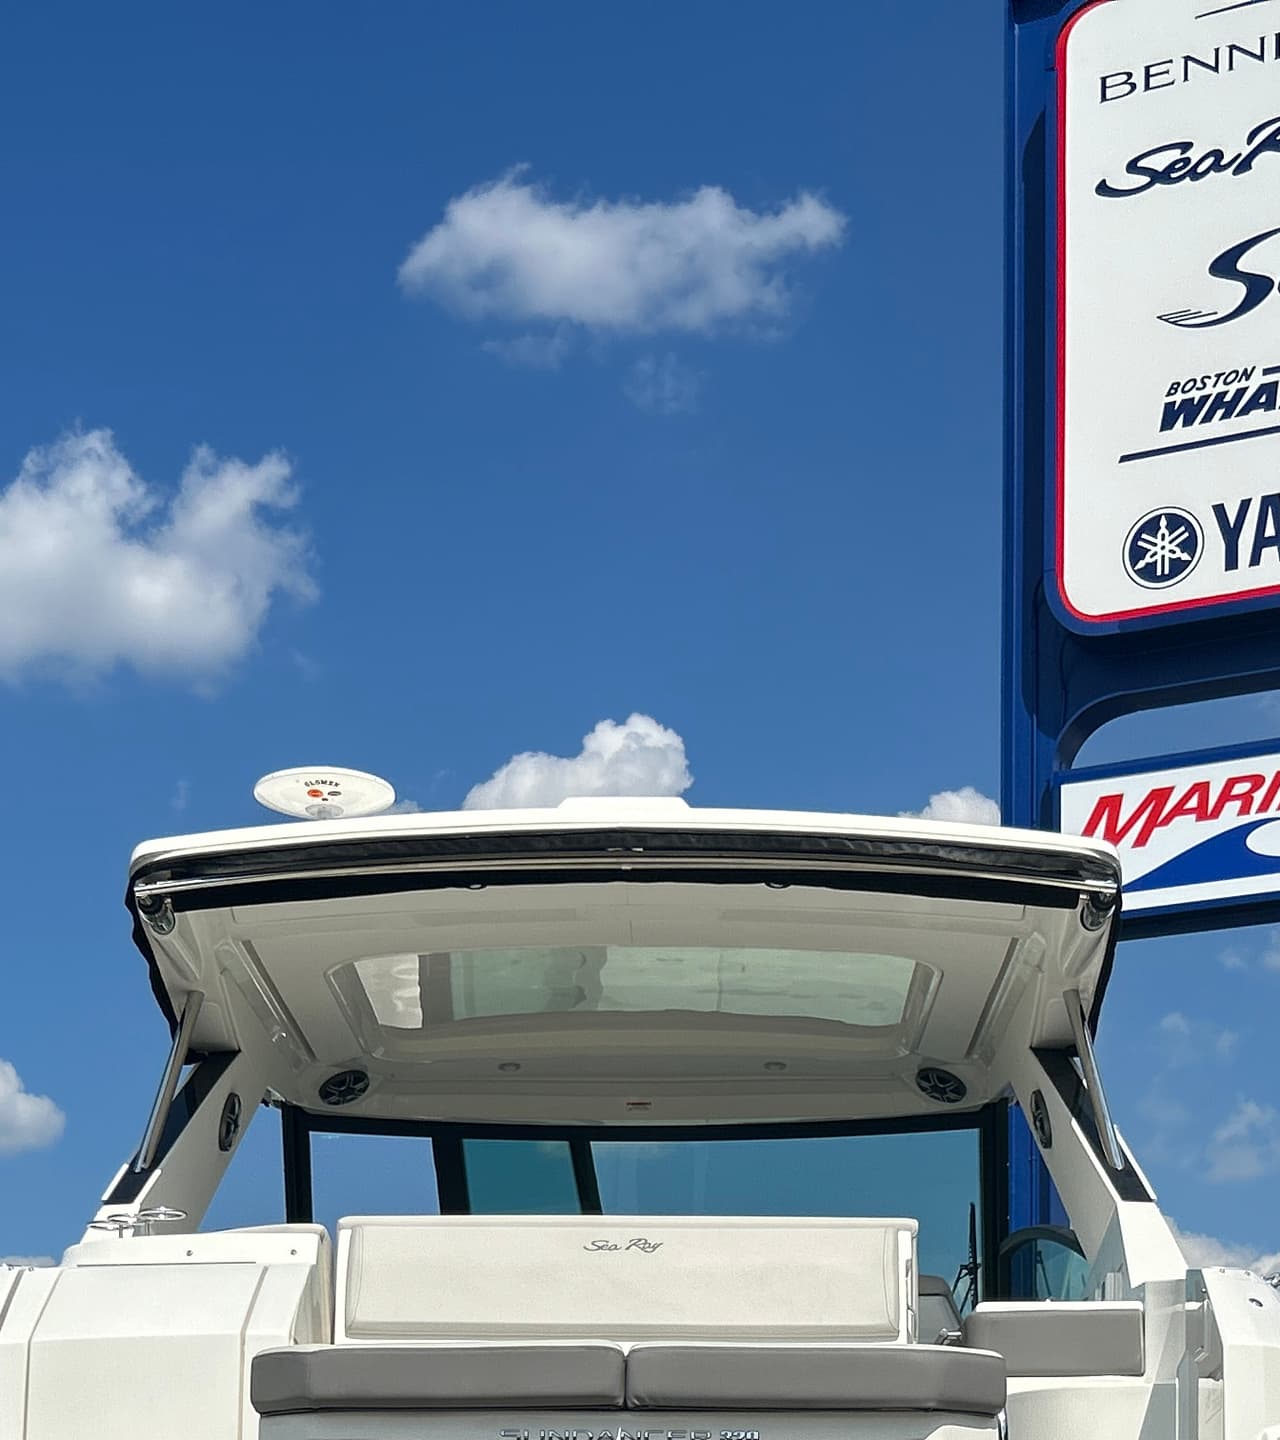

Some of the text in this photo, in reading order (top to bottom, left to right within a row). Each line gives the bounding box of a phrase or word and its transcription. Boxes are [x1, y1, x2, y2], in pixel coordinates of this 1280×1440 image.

[1164, 365, 1257, 398] BOSTON
[583, 1237, 664, 1254] Sea Ray
